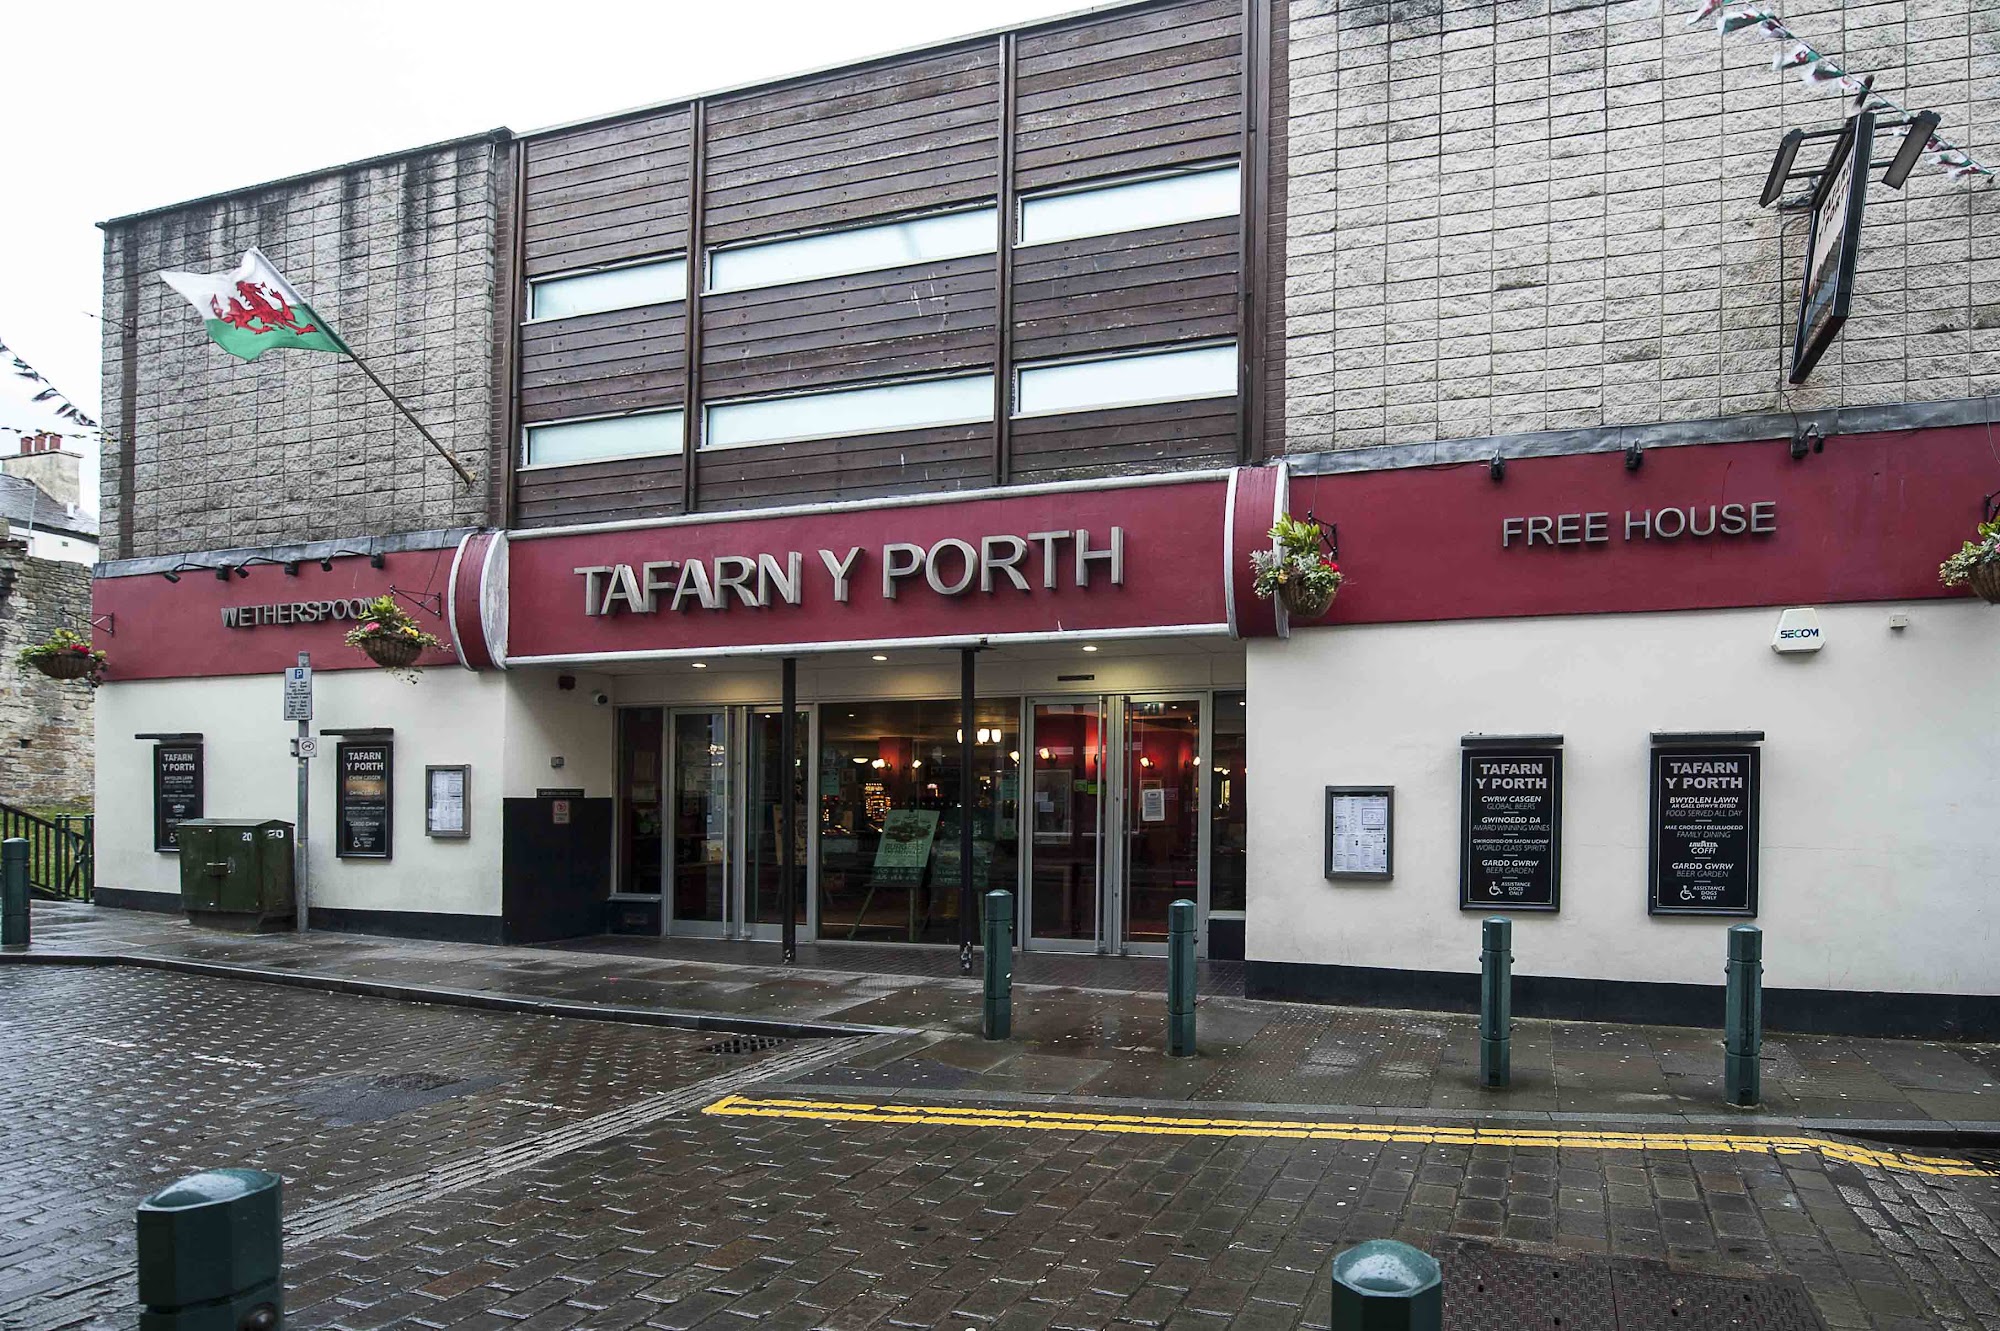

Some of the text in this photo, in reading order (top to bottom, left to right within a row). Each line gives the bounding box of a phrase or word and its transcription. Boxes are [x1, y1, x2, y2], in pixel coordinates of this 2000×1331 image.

[1502, 502, 1776, 547] FREE HOUSE
[574, 526, 1124, 616] TAFARN Y PORTH
[1780, 628, 1819, 638] SECOM
[348, 752, 381, 760] TAFARN
[354, 762, 384, 770] PORTH
[1480, 763, 1543, 775] TAFARN
[1670, 762, 1738, 774] TAFARN
[1476, 778, 1547, 789] Y PORTH
[1665, 777, 1742, 789] Y PORTH
[1670, 796, 1738, 804] BWYDLEN LAWN
[1482, 816, 1540, 824] GWINOEDD DA
[242, 832, 252, 841] 20
